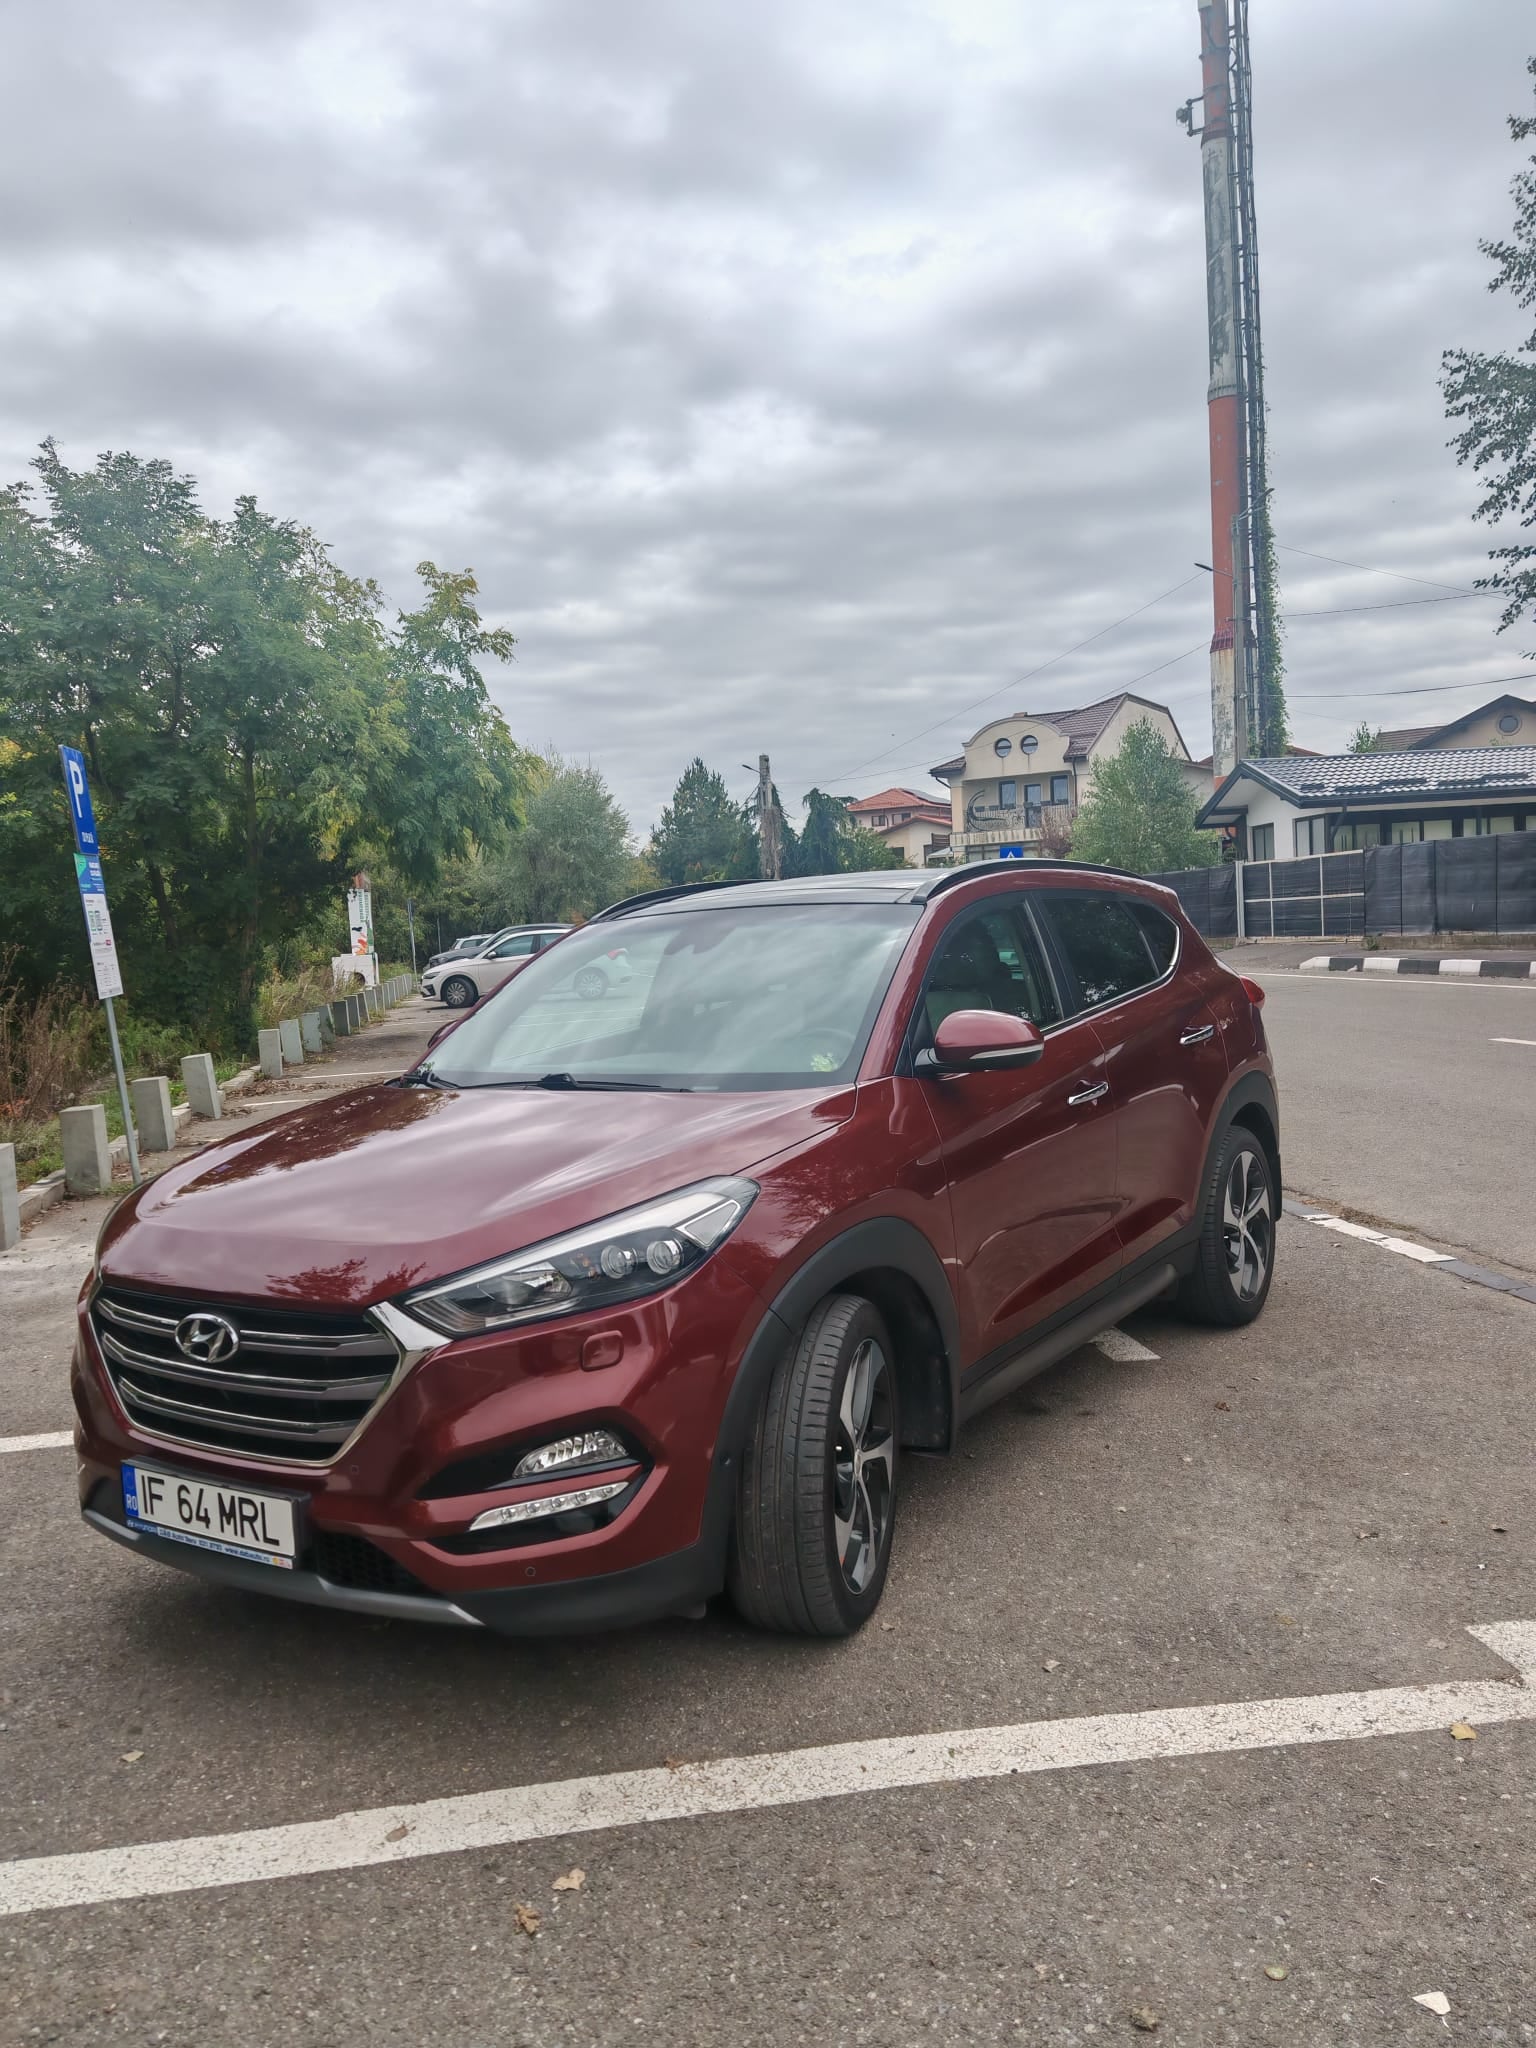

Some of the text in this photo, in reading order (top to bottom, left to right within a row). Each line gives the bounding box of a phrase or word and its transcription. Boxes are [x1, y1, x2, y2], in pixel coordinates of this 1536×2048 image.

[68, 760, 84, 818] P
[126, 1494, 138, 1511] RO
[141, 1475, 280, 1547] IF 64 MRL
